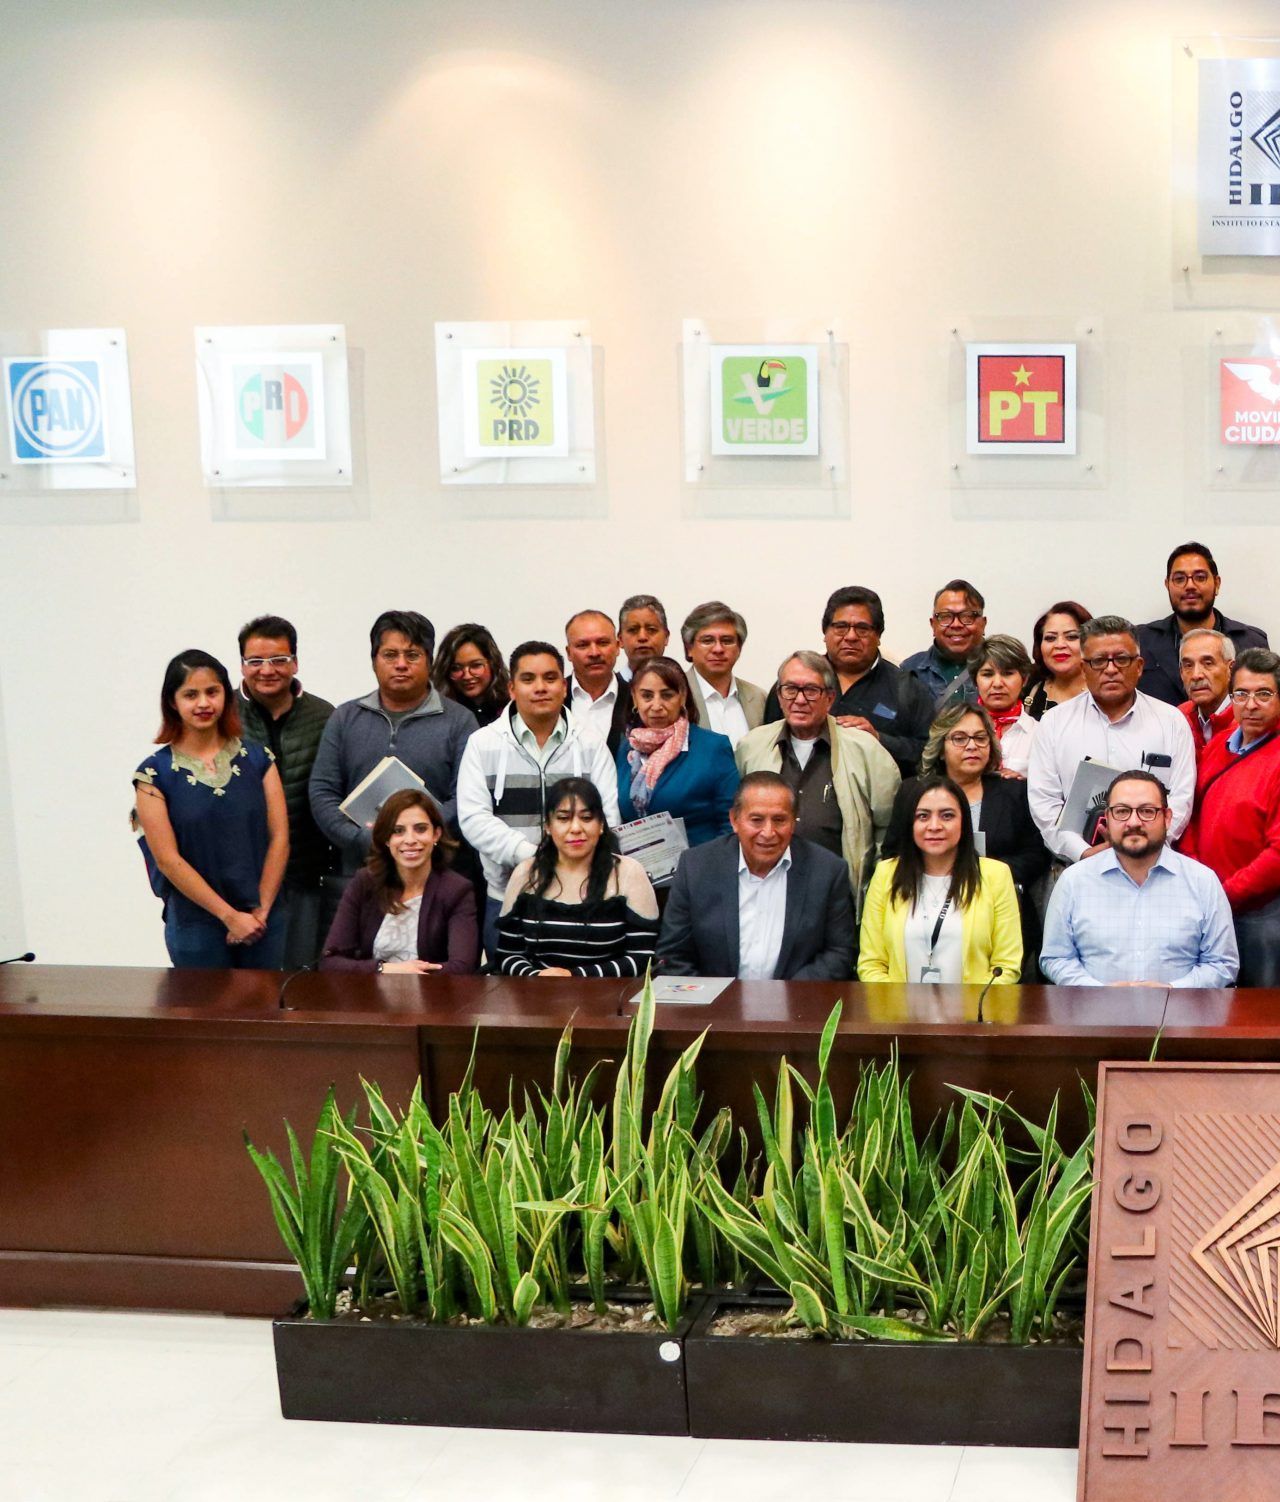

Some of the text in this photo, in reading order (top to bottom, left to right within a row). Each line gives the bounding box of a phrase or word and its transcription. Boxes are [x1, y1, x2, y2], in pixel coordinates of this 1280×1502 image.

[1229, 91, 1243, 205] HIDALGO
[1212, 219, 1257, 227] INSTITUTO
[30, 388, 85, 432] PAN
[243, 380, 300, 423] PRI
[989, 391, 1058, 436] PT
[493, 418, 540, 441] PRD
[726, 418, 804, 442] VERDE
[1102, 1113, 1165, 1458] HIDALGO
